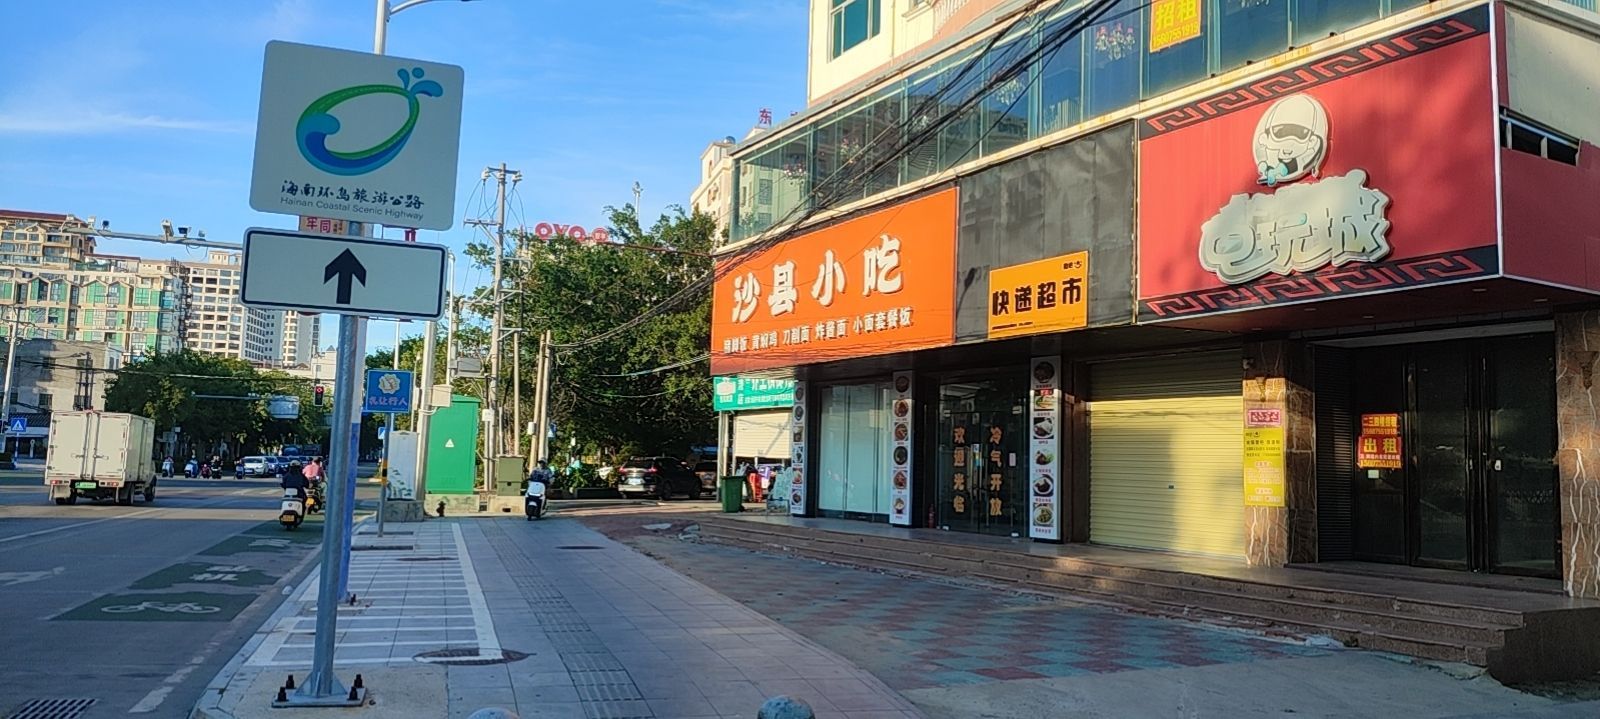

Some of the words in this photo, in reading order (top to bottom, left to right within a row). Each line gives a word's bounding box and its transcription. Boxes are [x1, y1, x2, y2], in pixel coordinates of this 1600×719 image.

[1155, 0, 1197, 31] 招租
[280, 197, 313, 207] Hainan
[316, 200, 350, 211] Coastal
[352, 205, 382, 215] Scenic
[385, 208, 424, 220] Highway
[281, 180, 424, 209] 海南环岛旅游公路
[731, 234, 904, 323] 沙县小吃
[992, 277, 1082, 316] 快递超市
[782, 325, 811, 345] 刀削面
[853, 307, 912, 334] 小面套餐饭
[1363, 437, 1398, 453] 出租
[953, 426, 966, 513] 欢迎光临
[989, 426, 1002, 516] 冷气开放
